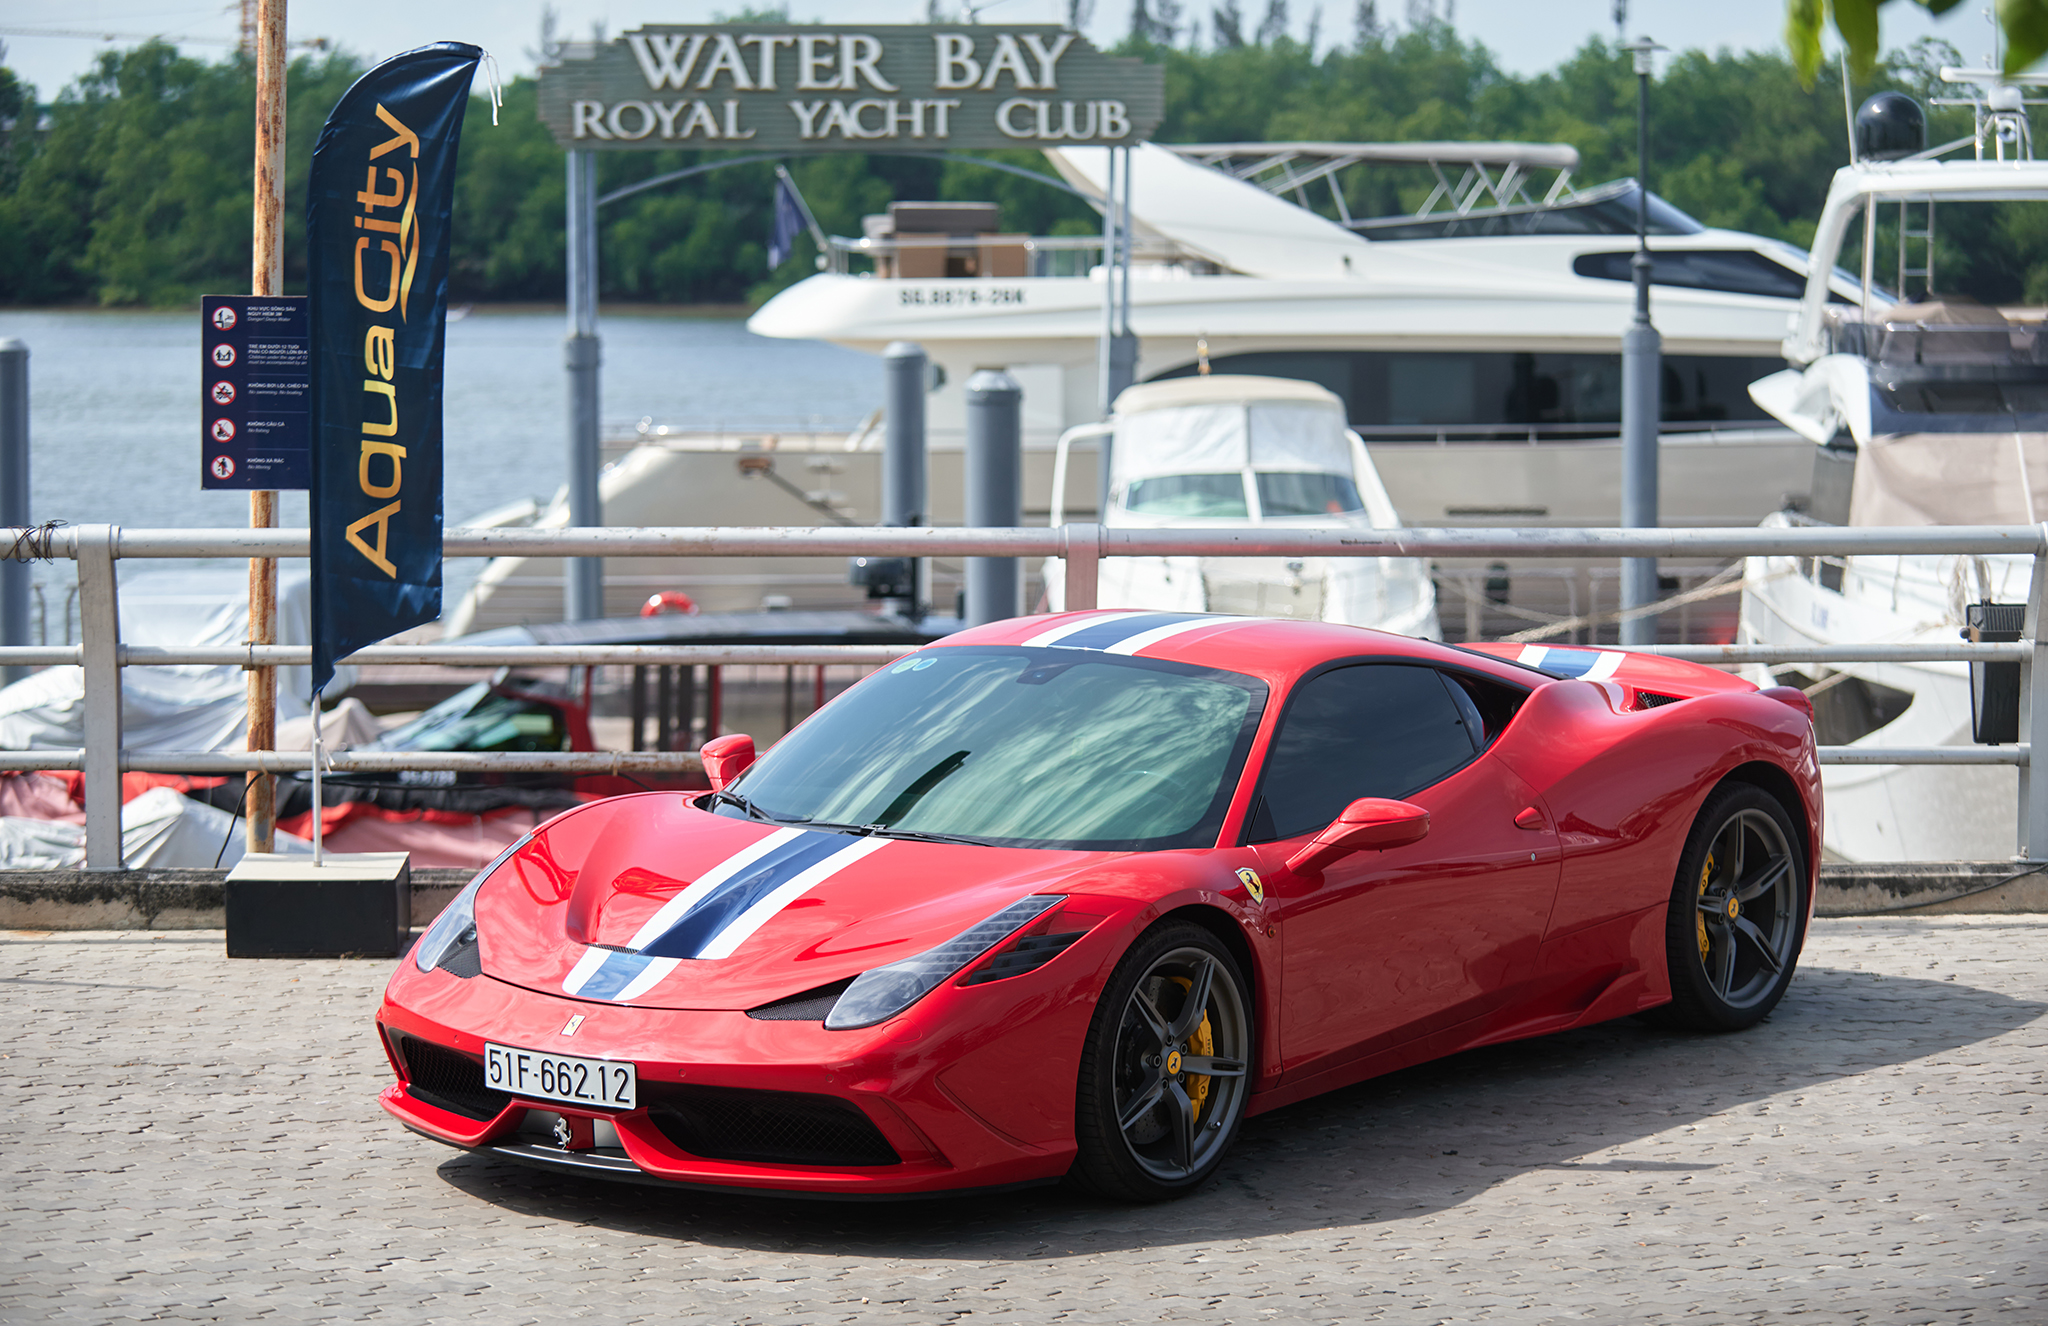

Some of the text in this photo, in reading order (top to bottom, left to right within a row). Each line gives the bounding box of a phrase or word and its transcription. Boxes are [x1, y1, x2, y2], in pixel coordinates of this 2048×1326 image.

[628, 33, 1076, 92] WATER BAY
[571, 97, 1131, 140] ROYAL YACHT CLUB
[489, 1048, 631, 1103] 51F-662.12
